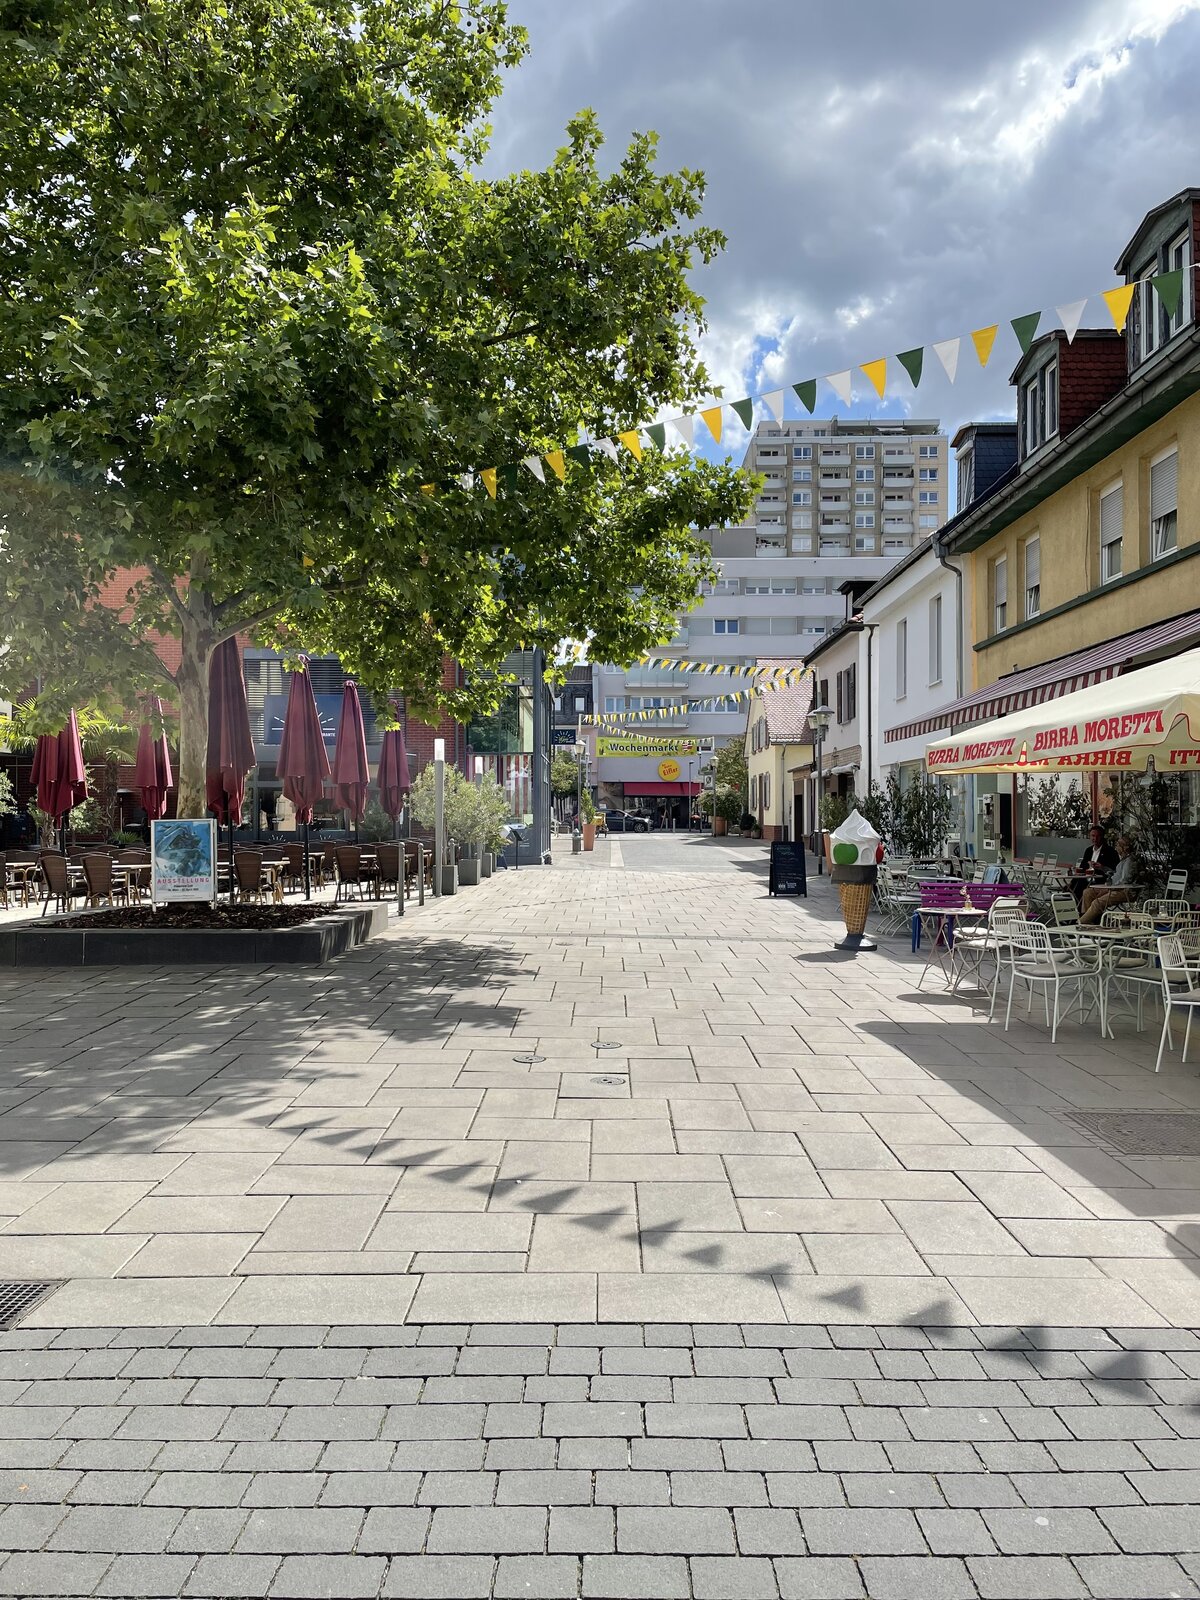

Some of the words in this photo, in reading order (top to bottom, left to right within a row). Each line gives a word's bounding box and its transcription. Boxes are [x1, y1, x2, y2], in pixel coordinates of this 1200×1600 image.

[1033, 725, 1078, 751] BIRRA
[1084, 709, 1164, 743] MORETTI
[610, 744, 678, 752] Wochenmarkt
[928, 747, 959, 766] BIRRA
[962, 738, 1016, 761] MORETTI
